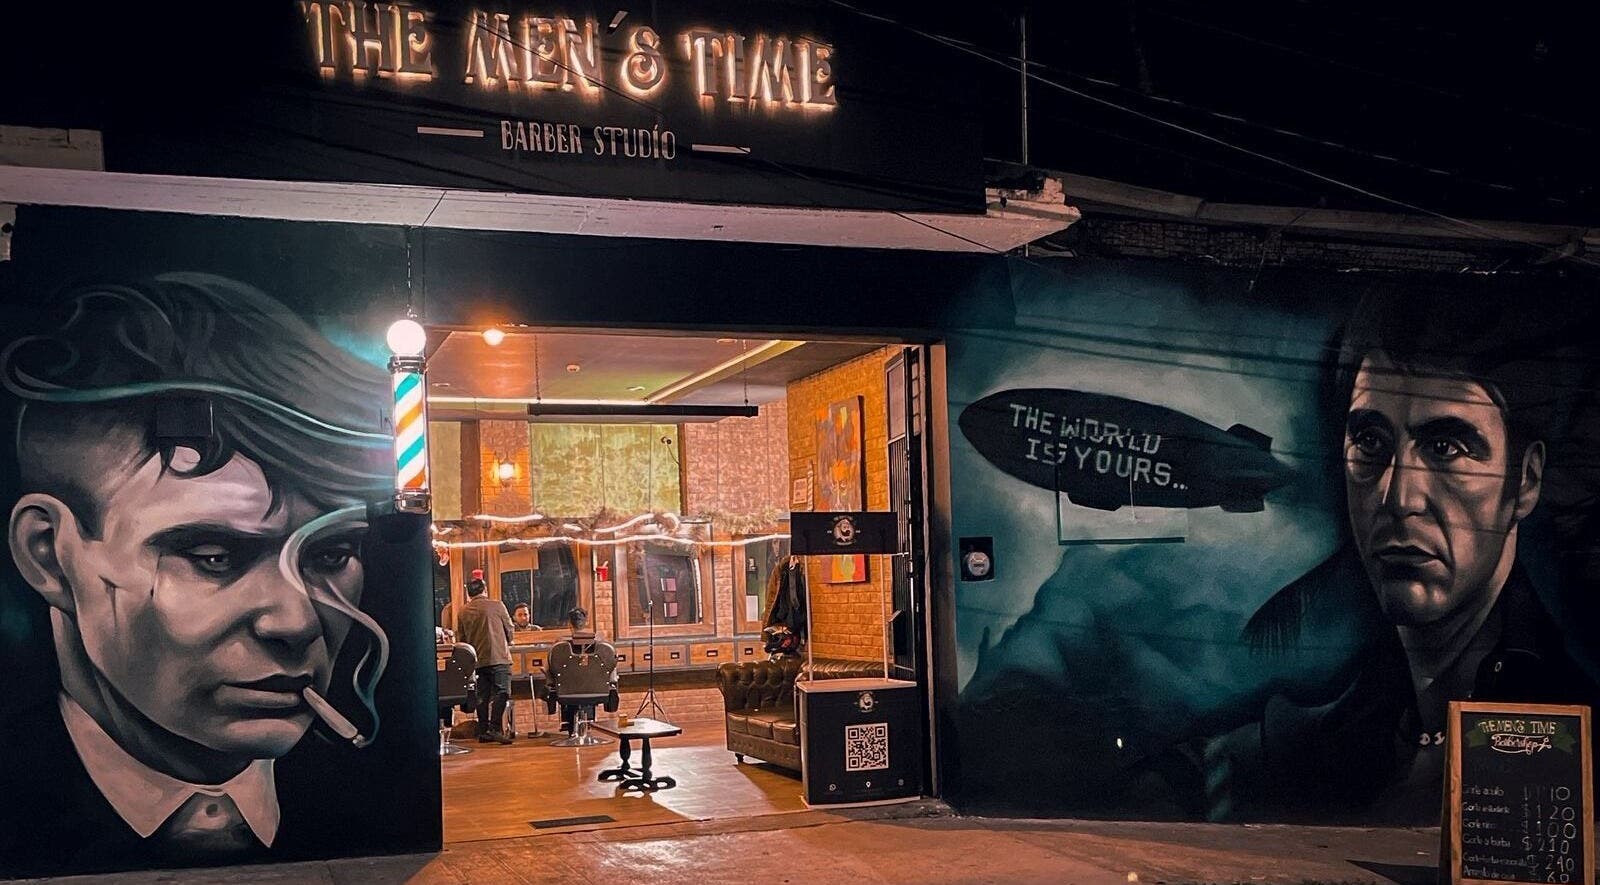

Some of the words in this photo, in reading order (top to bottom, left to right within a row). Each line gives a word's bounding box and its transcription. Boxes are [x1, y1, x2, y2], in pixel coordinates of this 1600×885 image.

[302, 1, 434, 76] THE
[680, 30, 837, 107] TIME
[500, 120, 584, 154] BARBER
[1009, 403, 1056, 434] THE
[1059, 415, 1162, 455] WORLD
[1530, 720, 1558, 735] TIME
